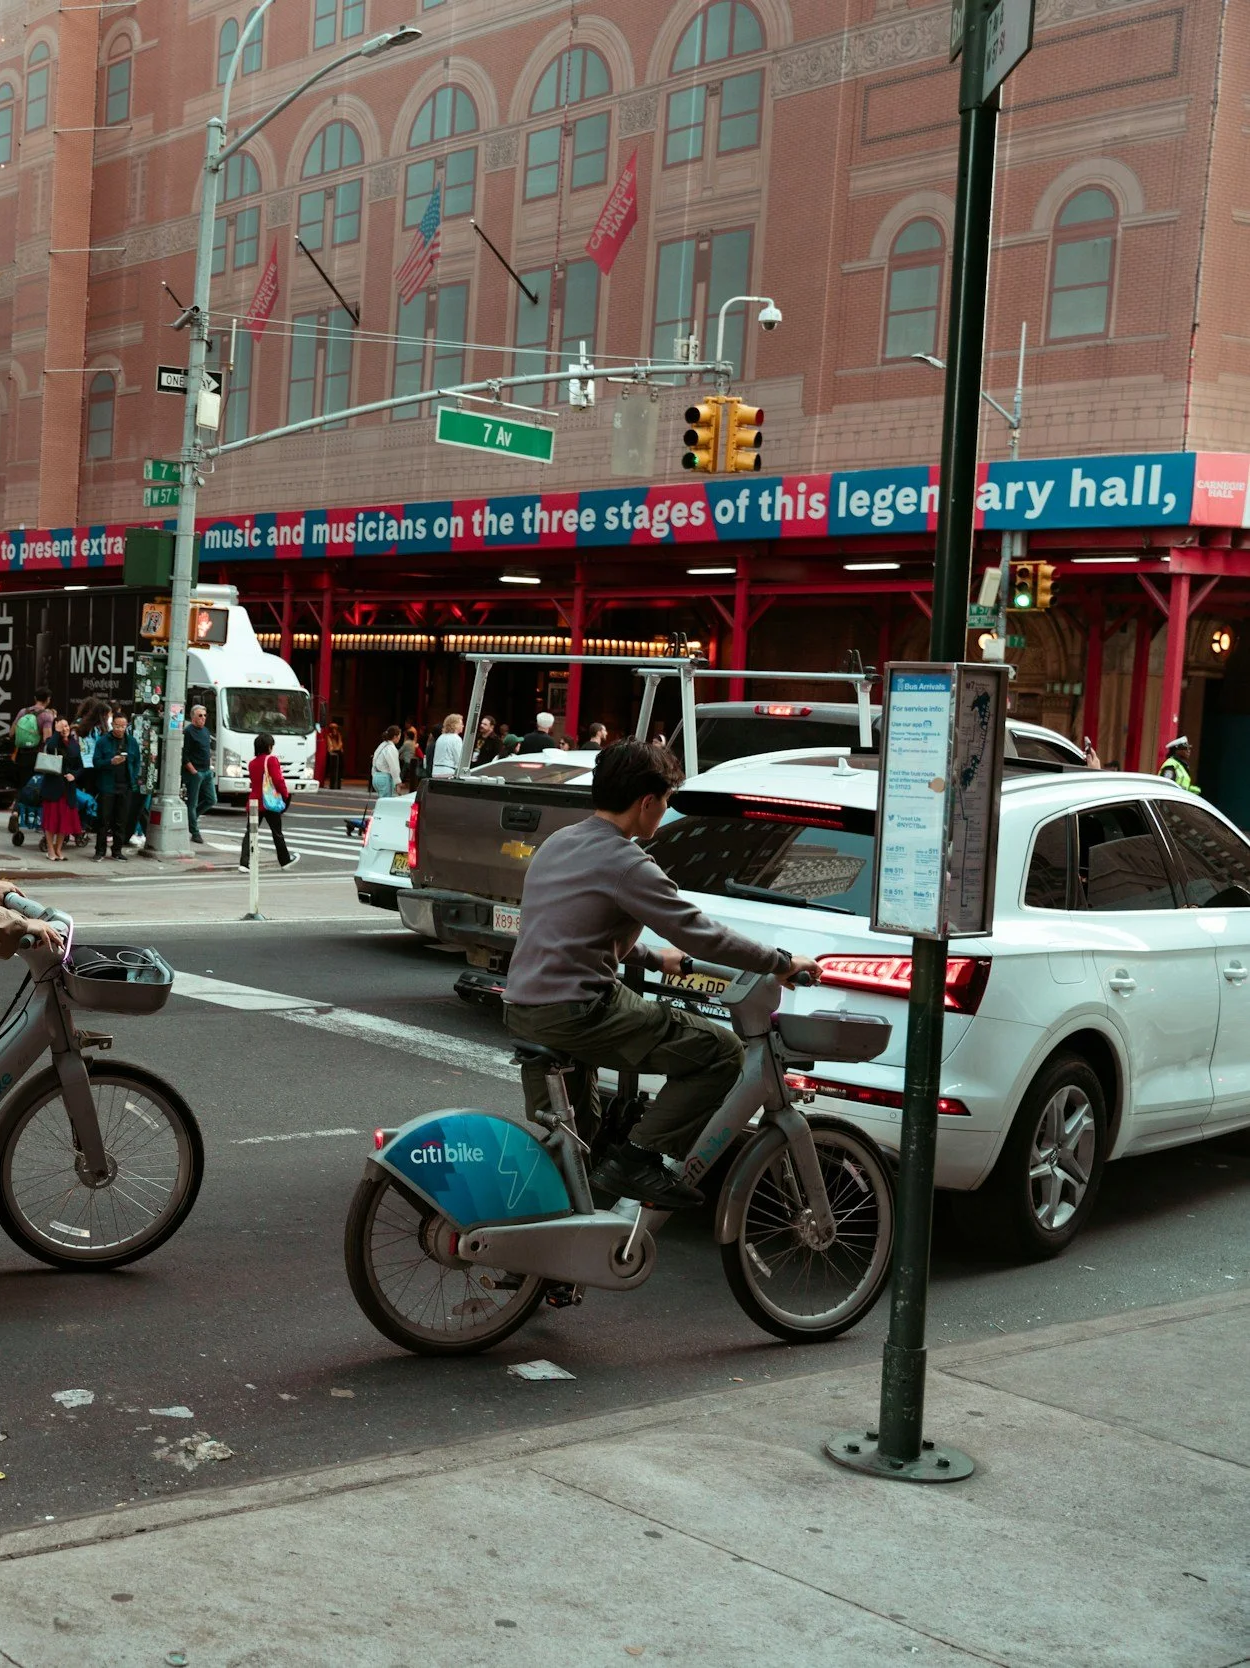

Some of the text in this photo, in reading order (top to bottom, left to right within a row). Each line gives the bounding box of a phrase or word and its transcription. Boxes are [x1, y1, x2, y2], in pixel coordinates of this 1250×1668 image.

[590, 169, 633, 250] CARNEGIE
[606, 196, 634, 239] HALL
[259, 283, 277, 315] HALL
[166, 374, 184, 386] ONE
[483, 422, 512, 447] 7 Av
[160, 464, 168, 478] 7
[152, 489, 159, 503] W
[160, 488, 172, 504] 57
[1196, 480, 1246, 491] CARNEGIE
[1208, 488, 1234, 499] HALL
[0, 541, 16, 560] to
[19, 536, 77, 564] present
[80, 533, 126, 557] extra
[204, 520, 262, 549] music
[266, 518, 306, 547] and
[312, 512, 427, 544] musicians
[433, 515, 464, 538] on
[472, 506, 514, 537] the
[522, 502, 596, 534] three
[604, 500, 706, 539] stages
[714, 488, 750, 524] of
[758, 482, 826, 522] this
[838, 481, 1055, 528] legenary
[1068, 464, 1177, 514] hall,
[70, 645, 135, 674] MYSLF
[671, 1000, 686, 1008] CK
[410, 1142, 484, 1164] citi bike
